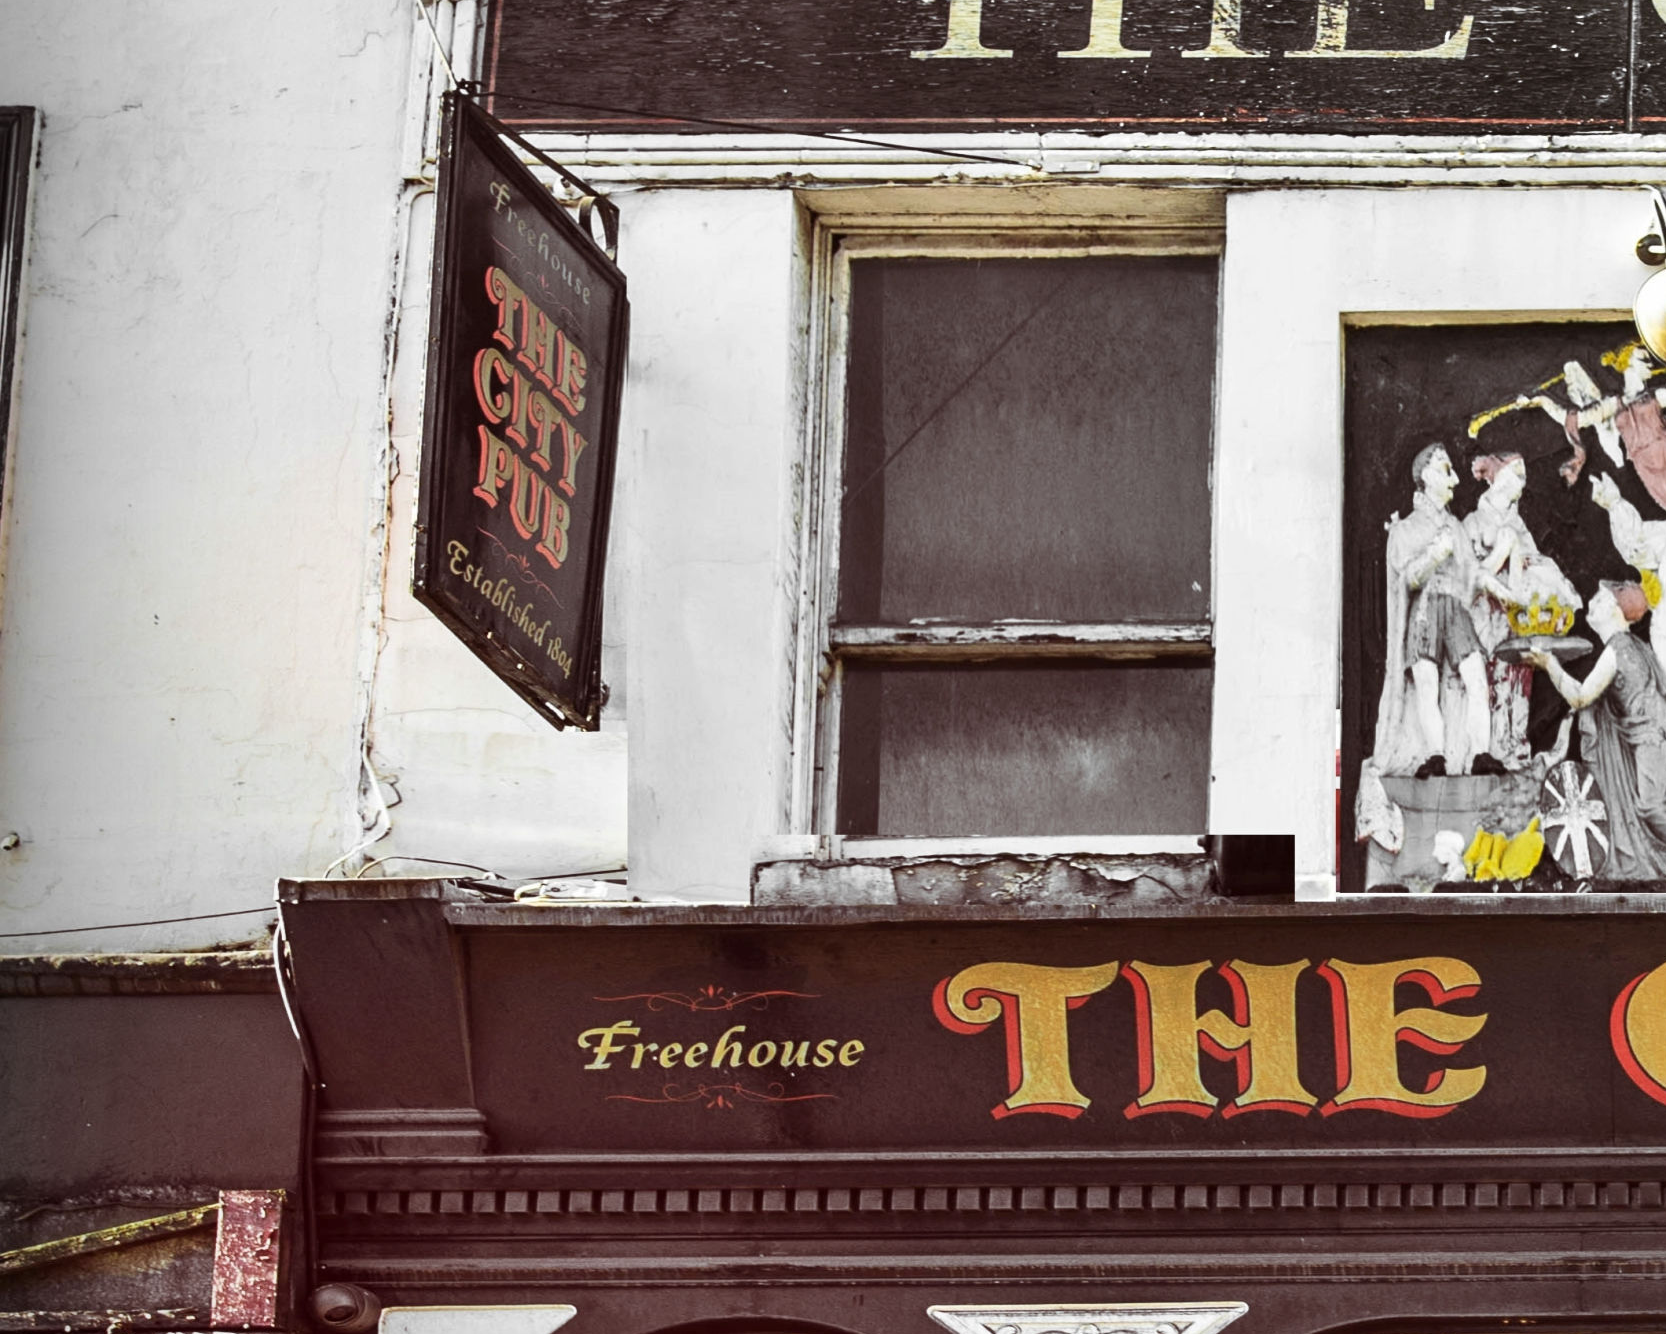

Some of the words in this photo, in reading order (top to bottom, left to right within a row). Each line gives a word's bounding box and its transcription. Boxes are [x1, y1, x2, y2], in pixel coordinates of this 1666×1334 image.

[489, 181, 591, 305] Freehouse
[485, 266, 588, 417] THE
[473, 348, 589, 497] CITY
[473, 424, 571, 569] PUB
[447, 539, 552, 648] Established
[547, 636, 574, 679] 1804
[578, 1021, 865, 1069] Freehouse
[932, 956, 1489, 1120] THE
